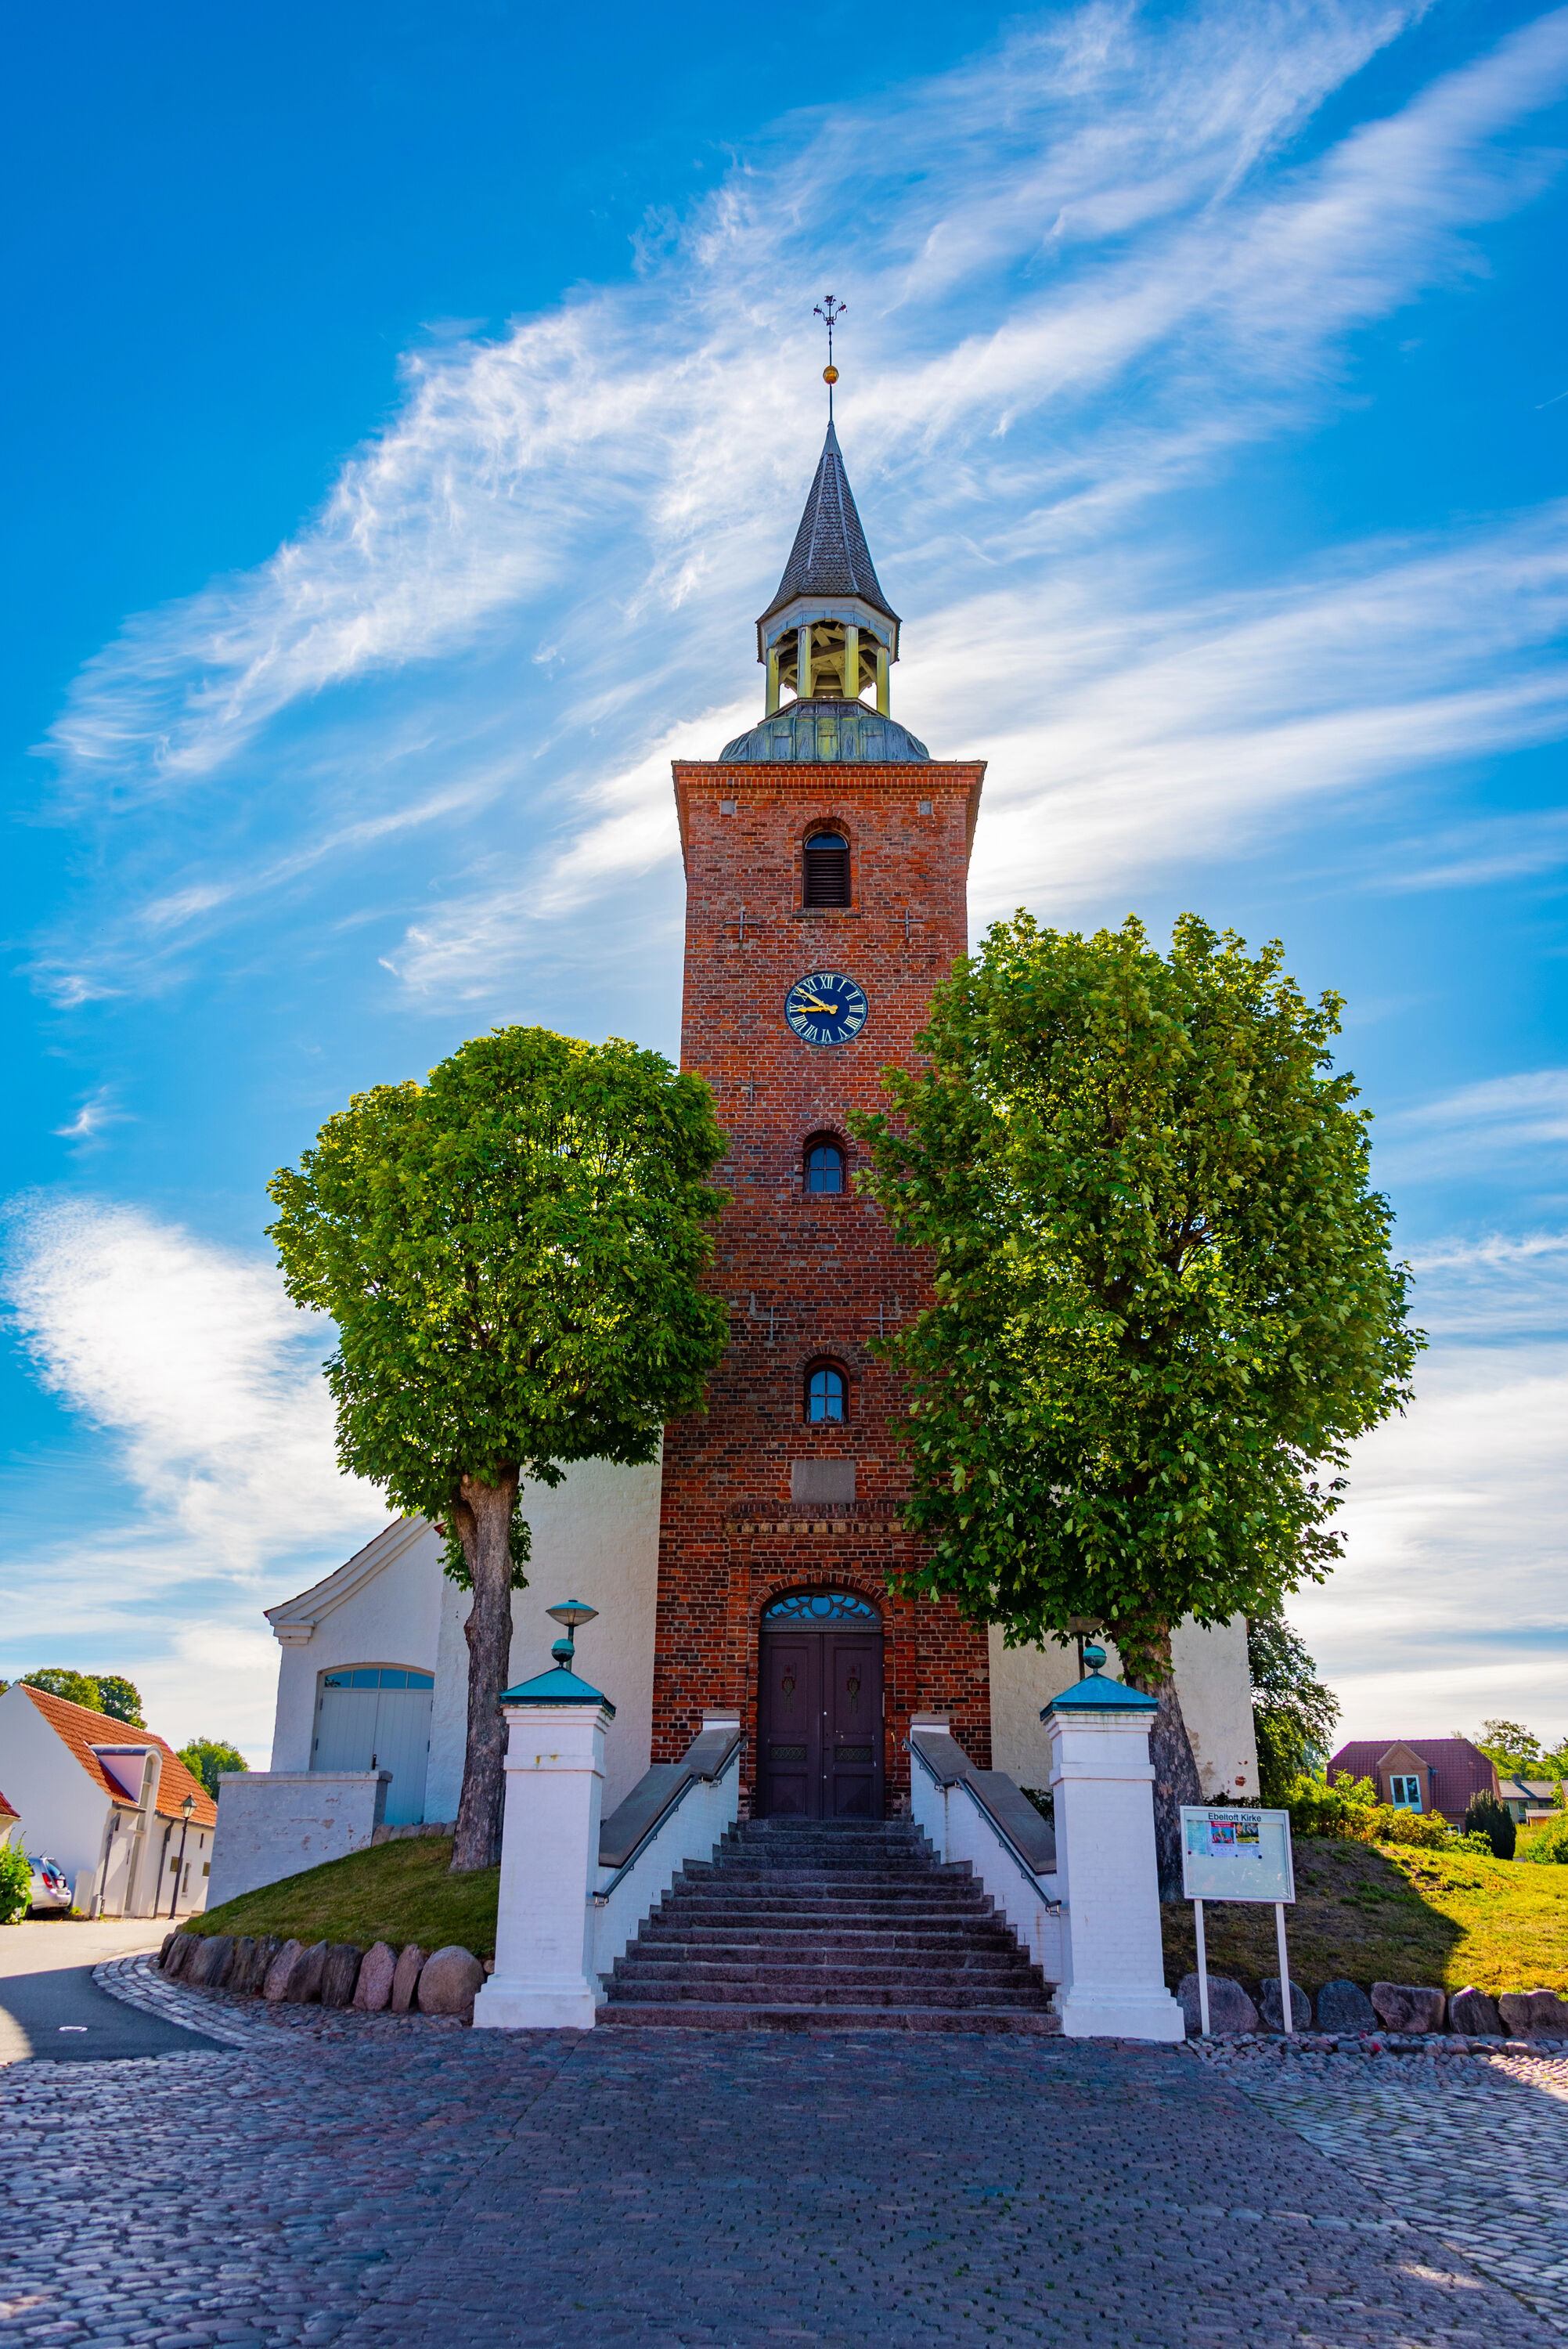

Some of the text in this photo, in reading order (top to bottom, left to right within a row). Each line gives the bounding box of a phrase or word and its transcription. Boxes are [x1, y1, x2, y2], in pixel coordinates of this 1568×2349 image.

[802, 978, 819, 994] XI
[820, 976, 834, 990] XII
[837, 979, 848, 993] I
[845, 990, 860, 1001] II
[849, 1004, 864, 1014] III
[791, 1014, 809, 1032] VIII
[844, 1015, 862, 1030] IIII
[802, 1024, 818, 1040] VII
[821, 1029, 833, 1042] VI
[837, 1027, 849, 1039] V
[1208, 1812, 1262, 1822] Ebeltoft Kirke
